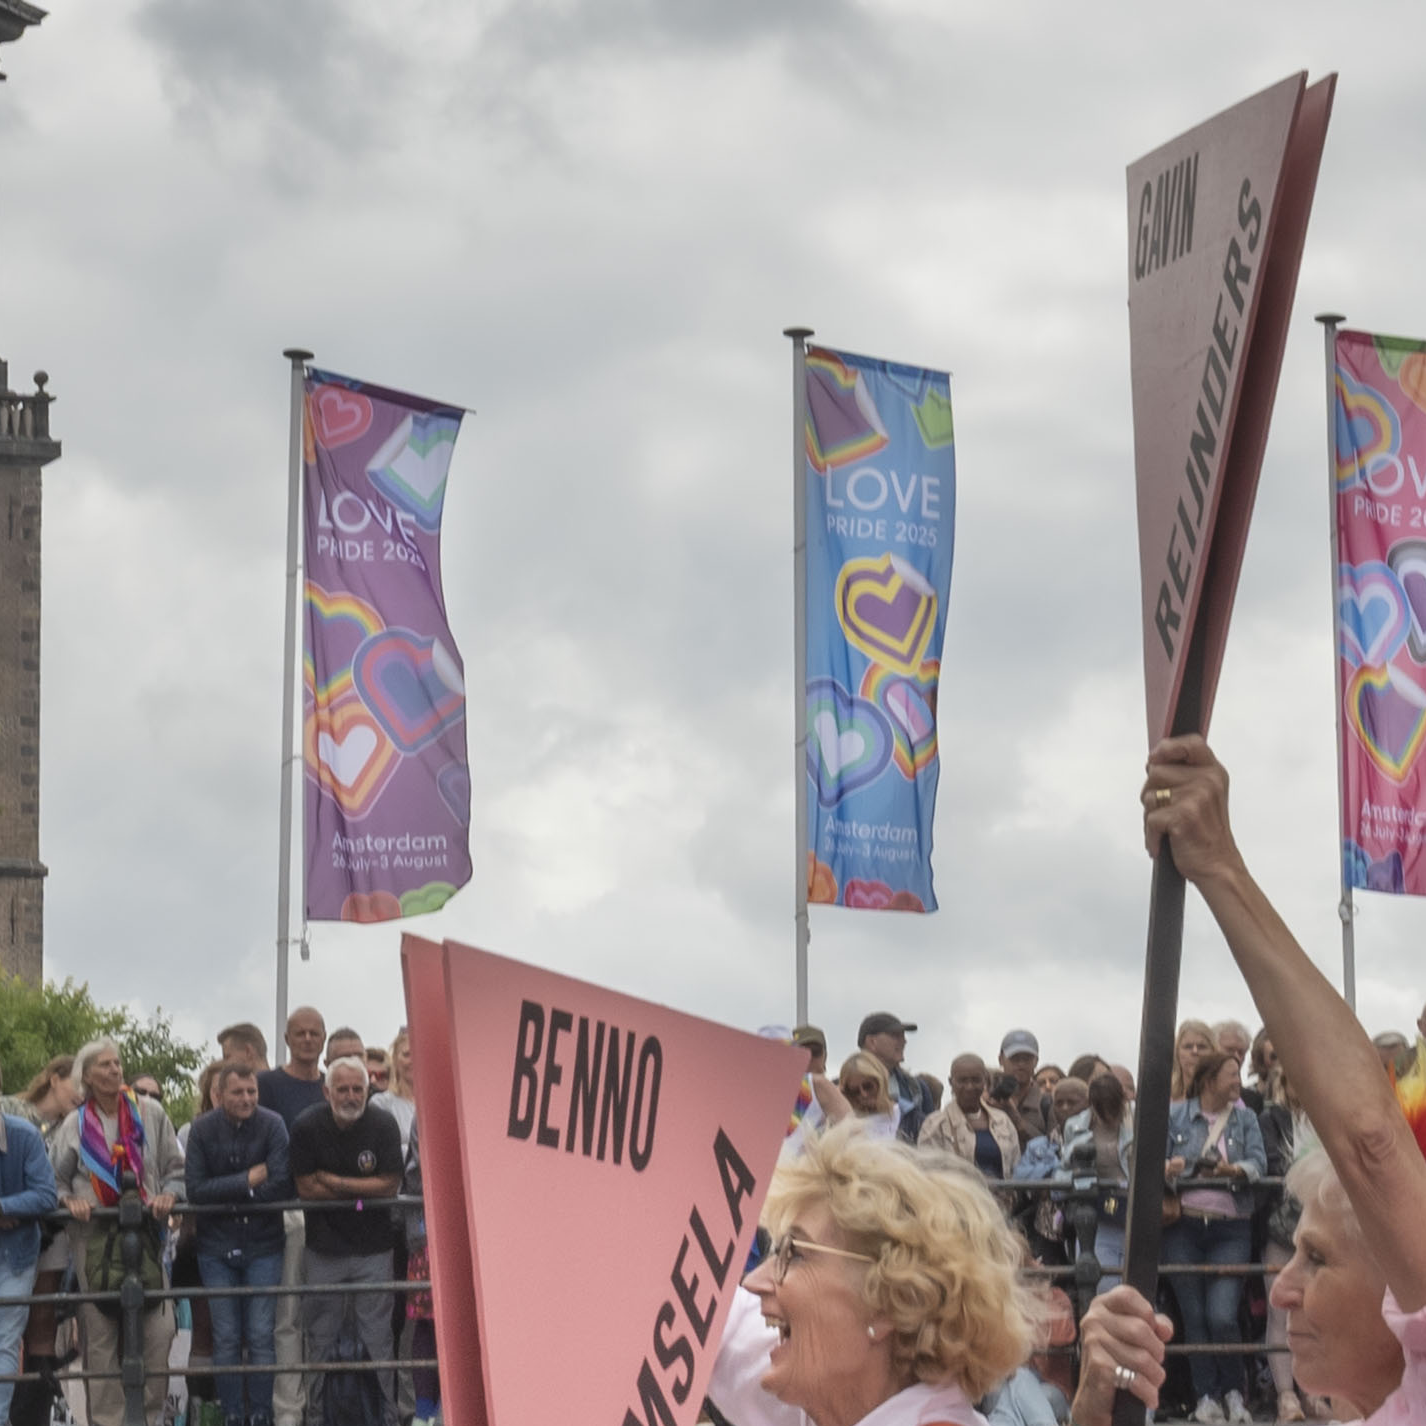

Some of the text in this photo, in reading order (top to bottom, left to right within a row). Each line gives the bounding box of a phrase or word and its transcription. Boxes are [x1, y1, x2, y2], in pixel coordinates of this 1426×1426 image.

[1135, 153, 1201, 282] GAVIN
[1154, 176, 1263, 664] REIJNDERS
[826, 464, 941, 520] LOVE
[318, 487, 418, 553] LOVE
[1354, 496, 1403, 527] PRIDE
[827, 513, 938, 548] PRIDE 2025
[317, 534, 374, 562] PRIDE
[331, 831, 448, 854] Amsterdam
[825, 814, 918, 843] Amsterdam
[380, 854, 389, 869] 3
[393, 854, 448, 871] August
[873, 844, 916, 863] August
[507, 999, 665, 1174] BENNO
